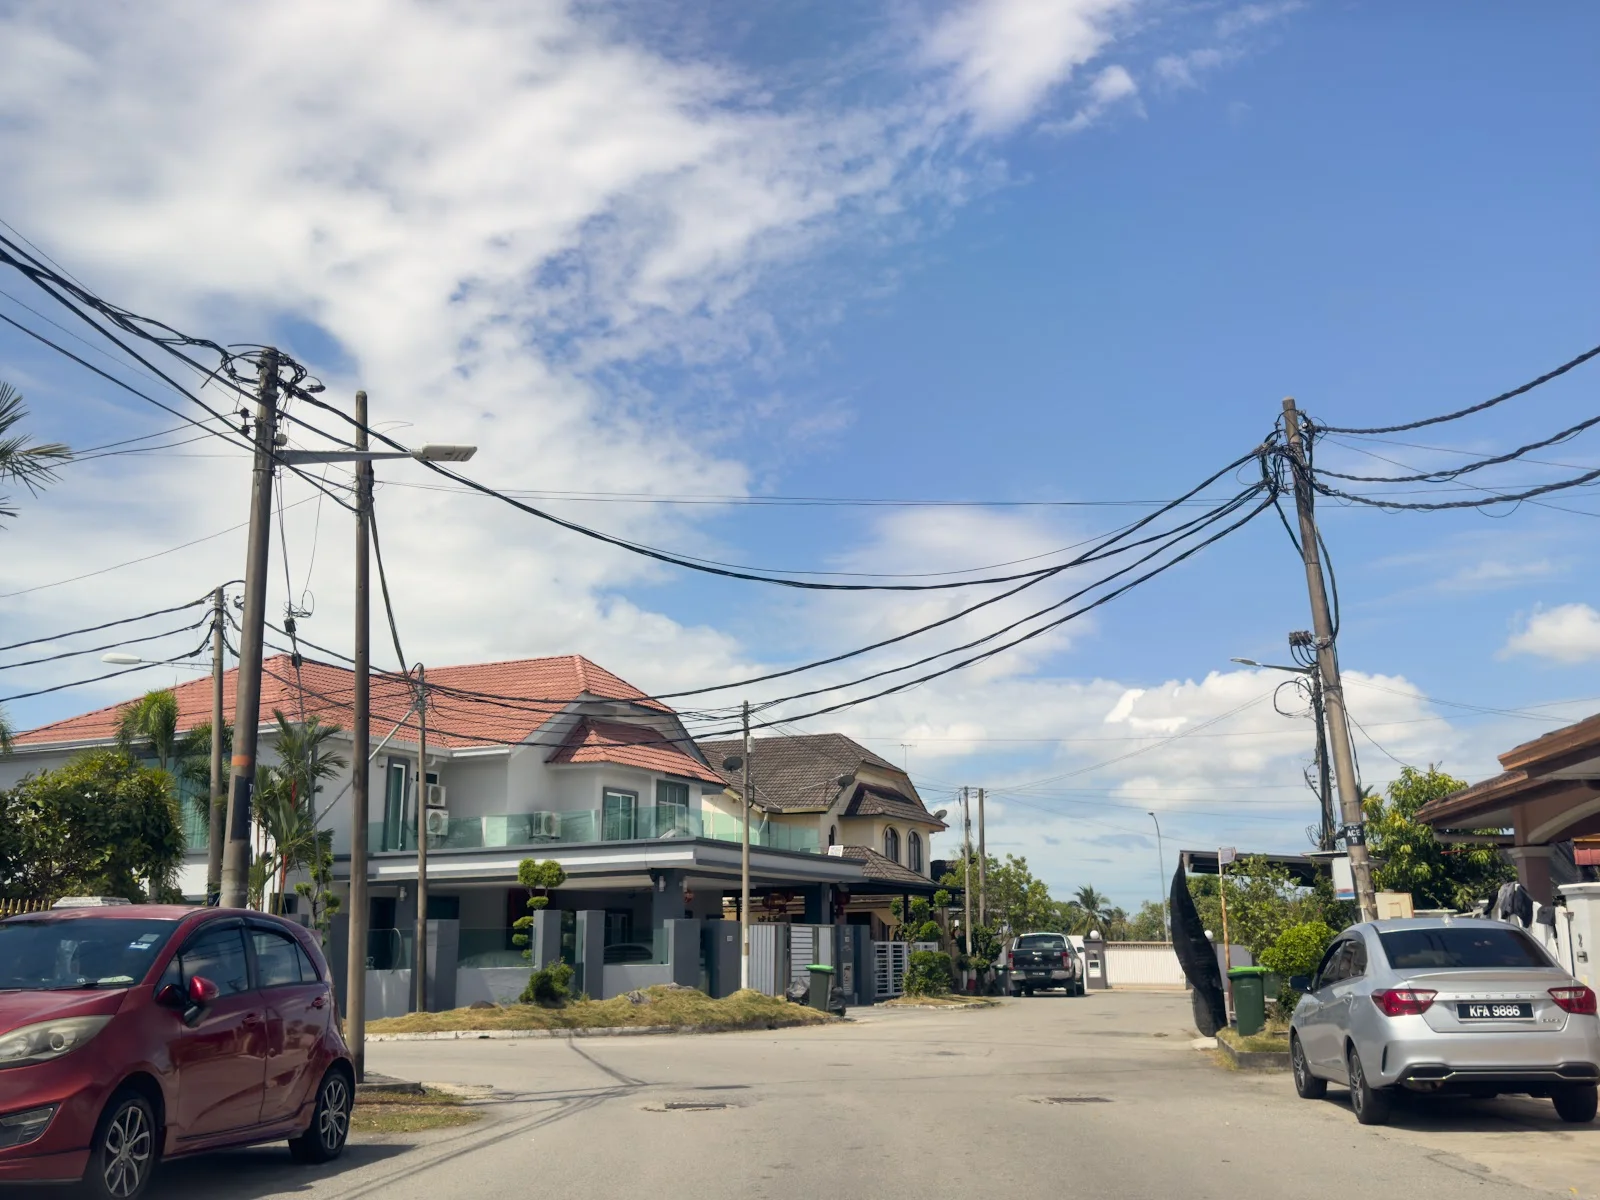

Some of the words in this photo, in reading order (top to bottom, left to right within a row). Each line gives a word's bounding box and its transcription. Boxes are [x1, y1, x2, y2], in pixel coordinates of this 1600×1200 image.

[1347, 829, 1361, 837] ACE
[1469, 1005, 1490, 1017] KFA
[1492, 1005, 1520, 1016] 9886
